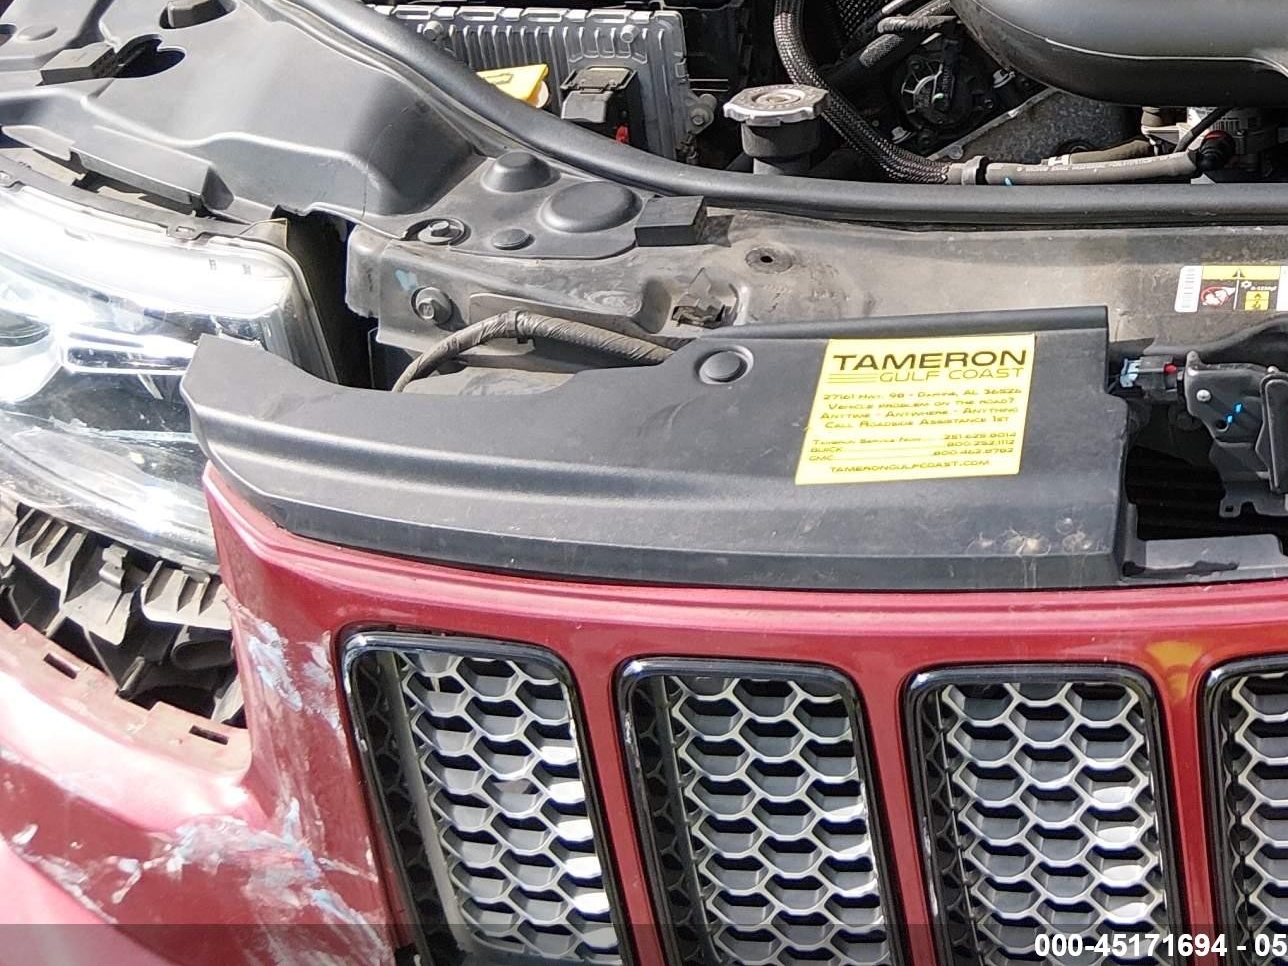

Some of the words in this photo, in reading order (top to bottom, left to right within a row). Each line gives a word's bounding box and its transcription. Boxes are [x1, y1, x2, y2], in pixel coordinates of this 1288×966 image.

[833, 350, 1026, 370] TAMERON
[879, 371, 940, 382] GULF
[948, 367, 1024, 380] COAST
